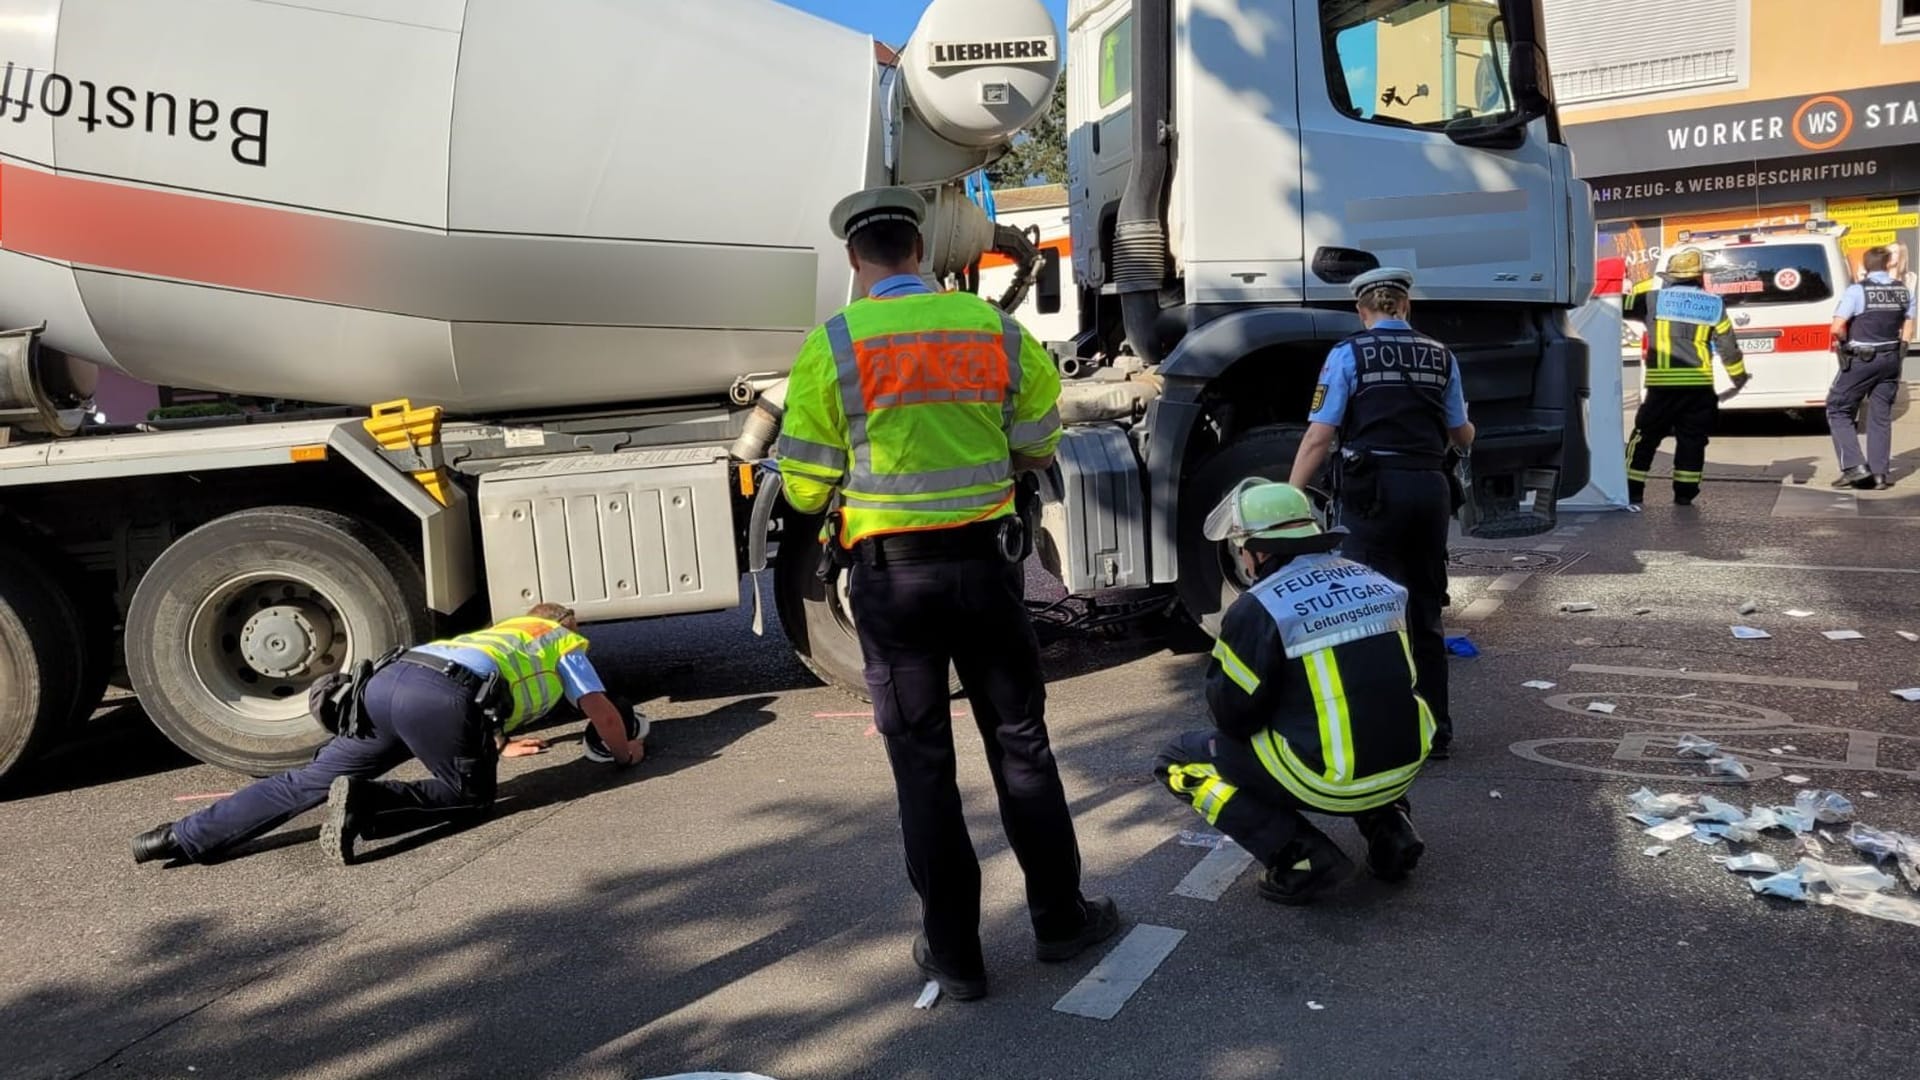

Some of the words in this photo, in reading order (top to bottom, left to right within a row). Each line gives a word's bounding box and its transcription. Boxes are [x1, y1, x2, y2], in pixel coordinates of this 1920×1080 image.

[934, 40, 1048, 62] LIEBHERR
[1667, 116, 1784, 150] WORKER
[1807, 111, 1838, 134] WS
[1865, 100, 1920, 128] STA
[1593, 182, 1671, 202] AHRZEUG-
[1675, 181, 1684, 194] &
[1688, 160, 1878, 193] WERBEBESCHRIFTUNG
[1791, 331, 1823, 345] KIT
[871, 348, 998, 385] POLIZEI
[1362, 344, 1447, 371] POLIZEI
[1293, 583, 1396, 616] STUTTGART
